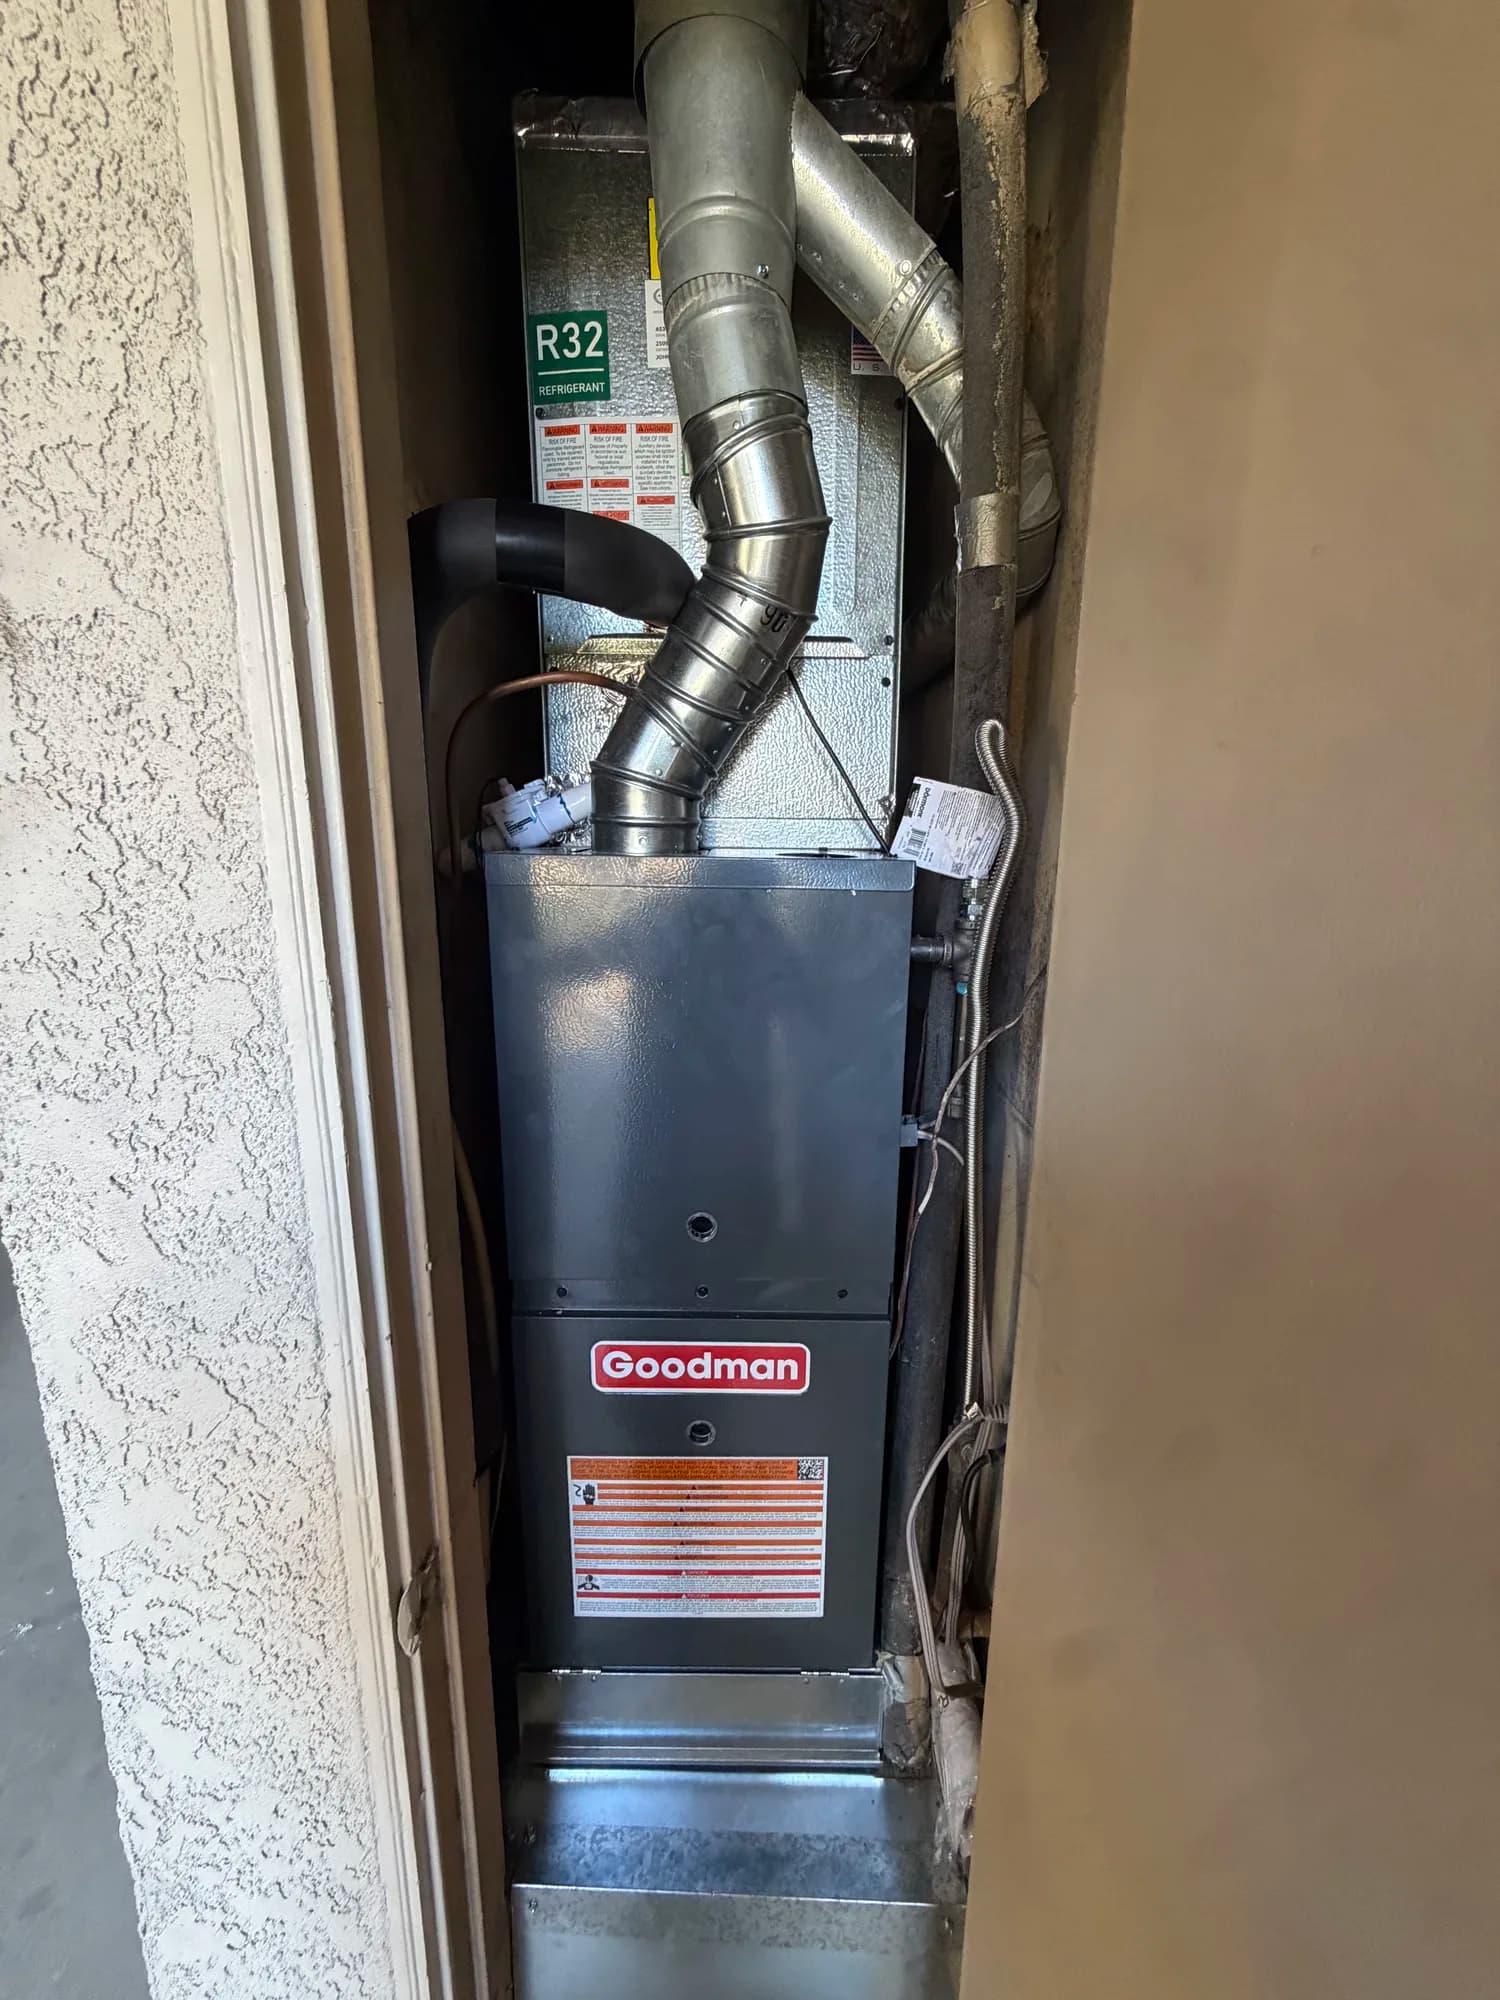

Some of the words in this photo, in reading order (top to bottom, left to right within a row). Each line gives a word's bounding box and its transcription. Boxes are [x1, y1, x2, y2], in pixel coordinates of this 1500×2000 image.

[536, 321, 604, 361] R32
[539, 382, 605, 397] REFRIGERANT
[601, 1350, 799, 1380] Goodman
